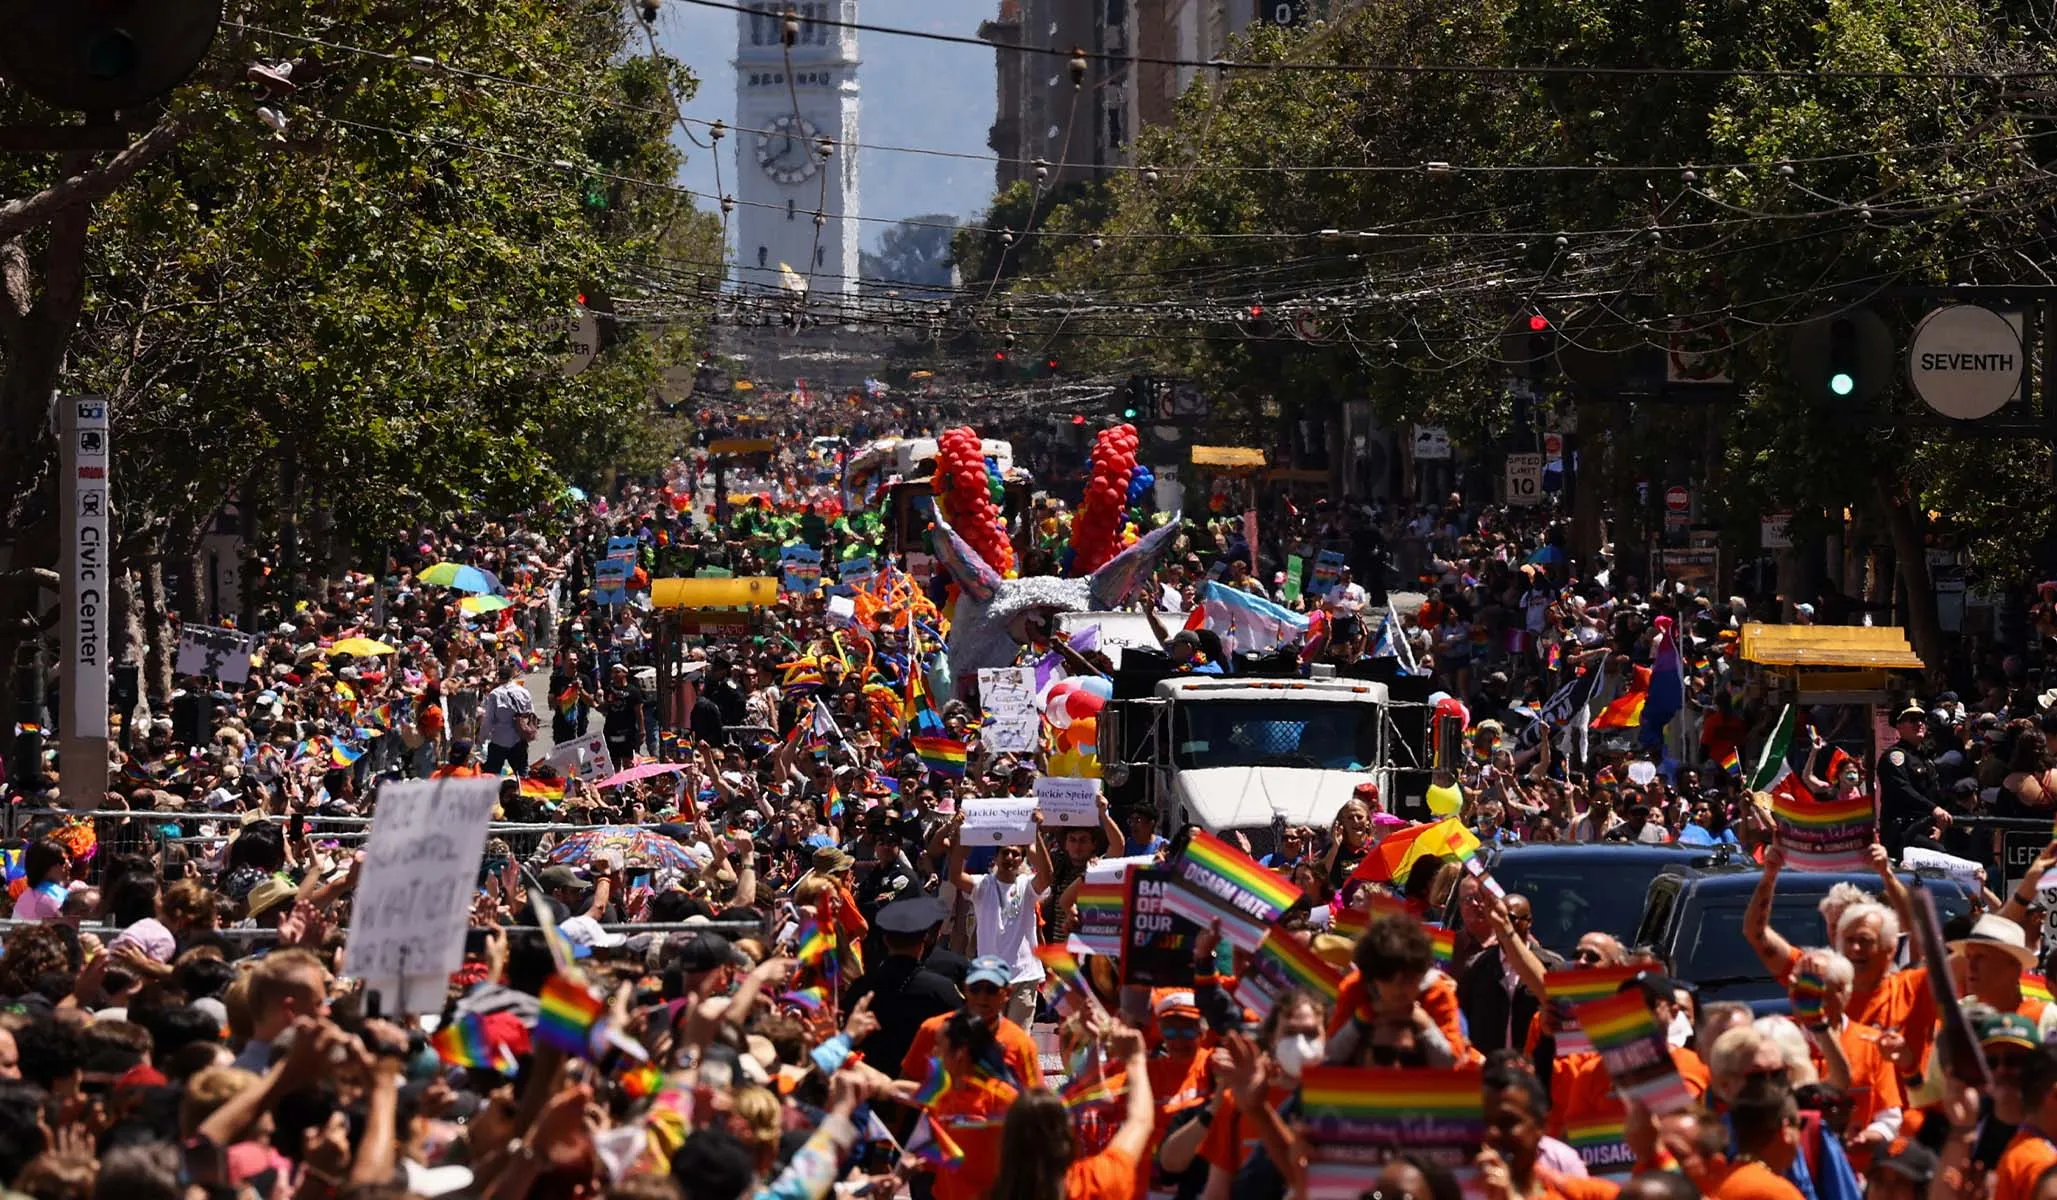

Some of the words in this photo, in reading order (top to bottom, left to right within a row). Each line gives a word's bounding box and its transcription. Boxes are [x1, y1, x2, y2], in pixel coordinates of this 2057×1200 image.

[1921, 353, 2013, 371] SEVENTH
[1508, 456, 1540, 465] SPEED
[1511, 478, 1534, 495] 10
[80, 526, 102, 580] Civic
[80, 592, 101, 667] Center
[1184, 863, 1237, 901] DISARM
[1233, 887, 1273, 921] HATE
[1135, 914, 1173, 932] OUR
[1582, 1143, 1637, 1165] DISAR
